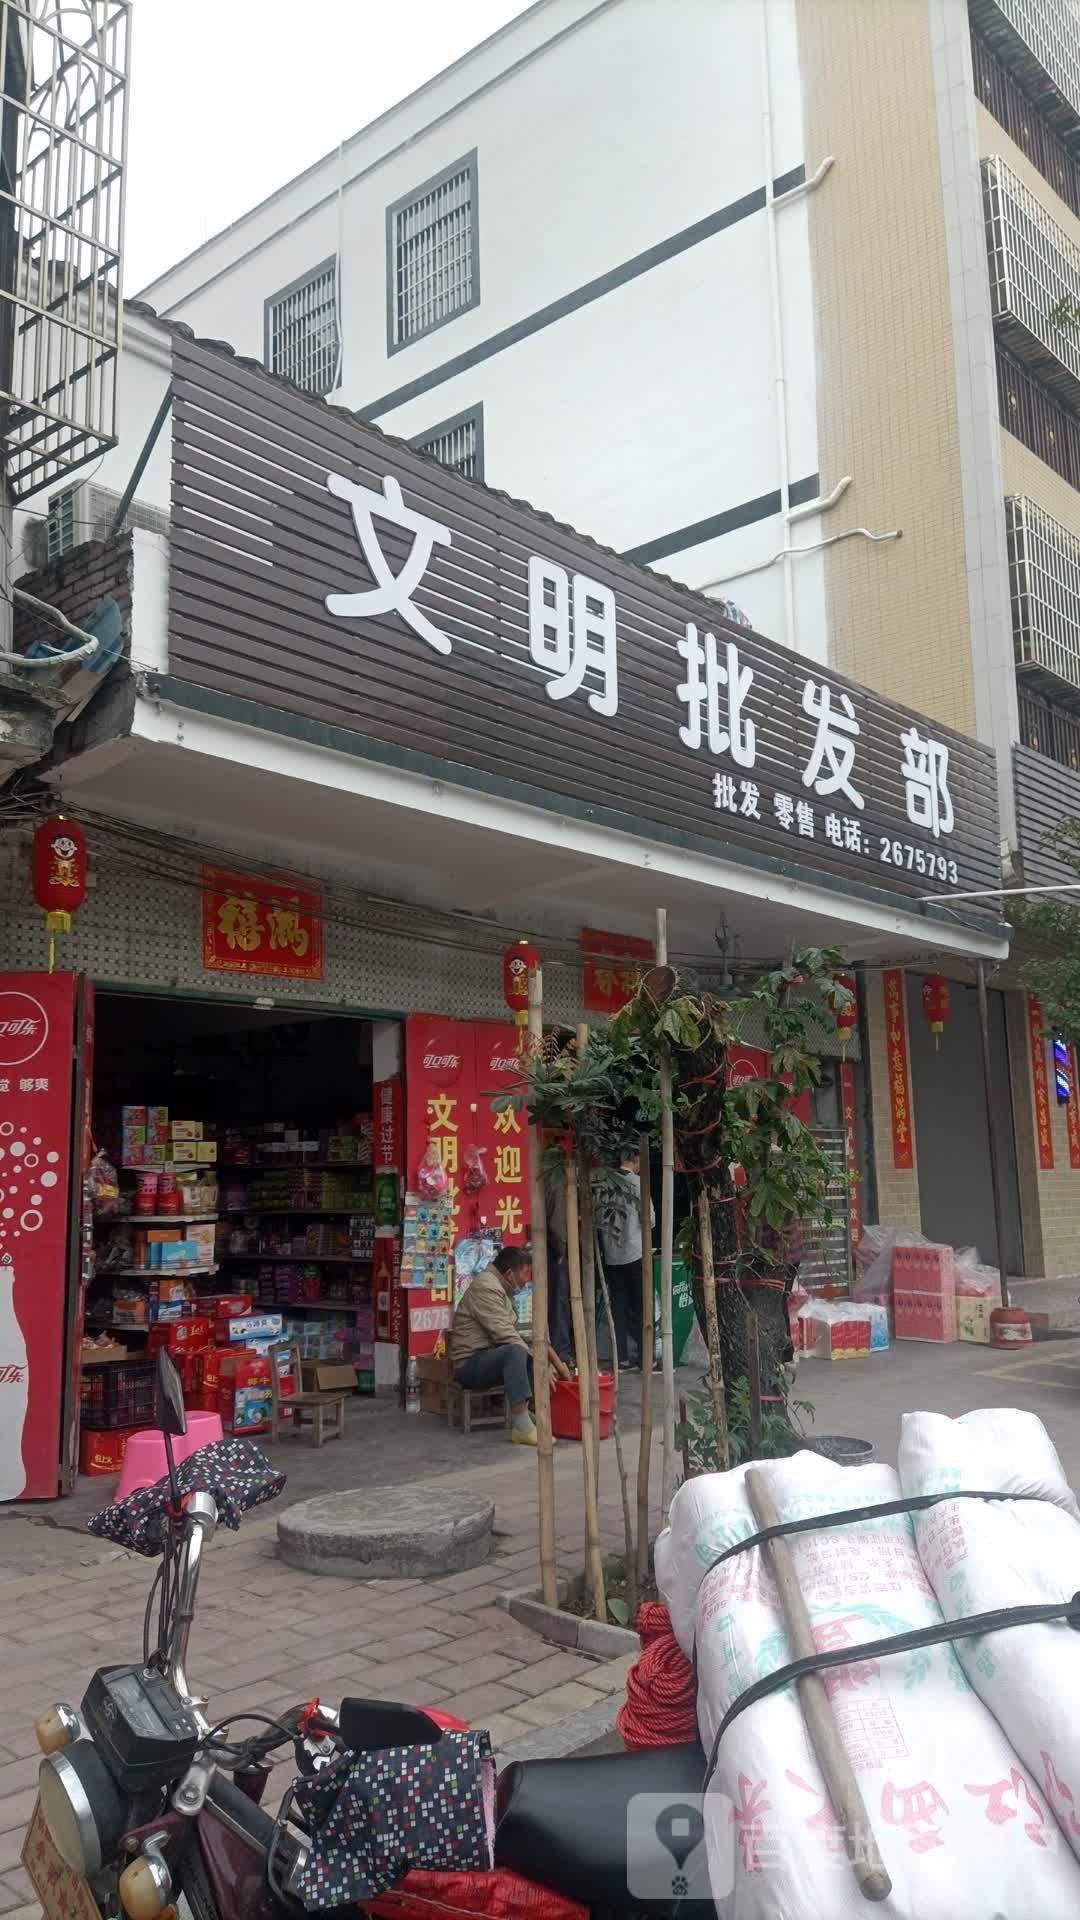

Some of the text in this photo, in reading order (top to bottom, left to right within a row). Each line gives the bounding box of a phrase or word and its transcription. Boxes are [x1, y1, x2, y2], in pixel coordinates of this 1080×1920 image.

[325, 474, 956, 838] 文明批发部
[712, 773, 761, 820] 批发
[773, 793, 815, 838] 零售
[880, 837, 958, 884] 2675793
[19, 1078, 48, 1092] 够爽
[423, 1054, 460, 1069] 可口可乐
